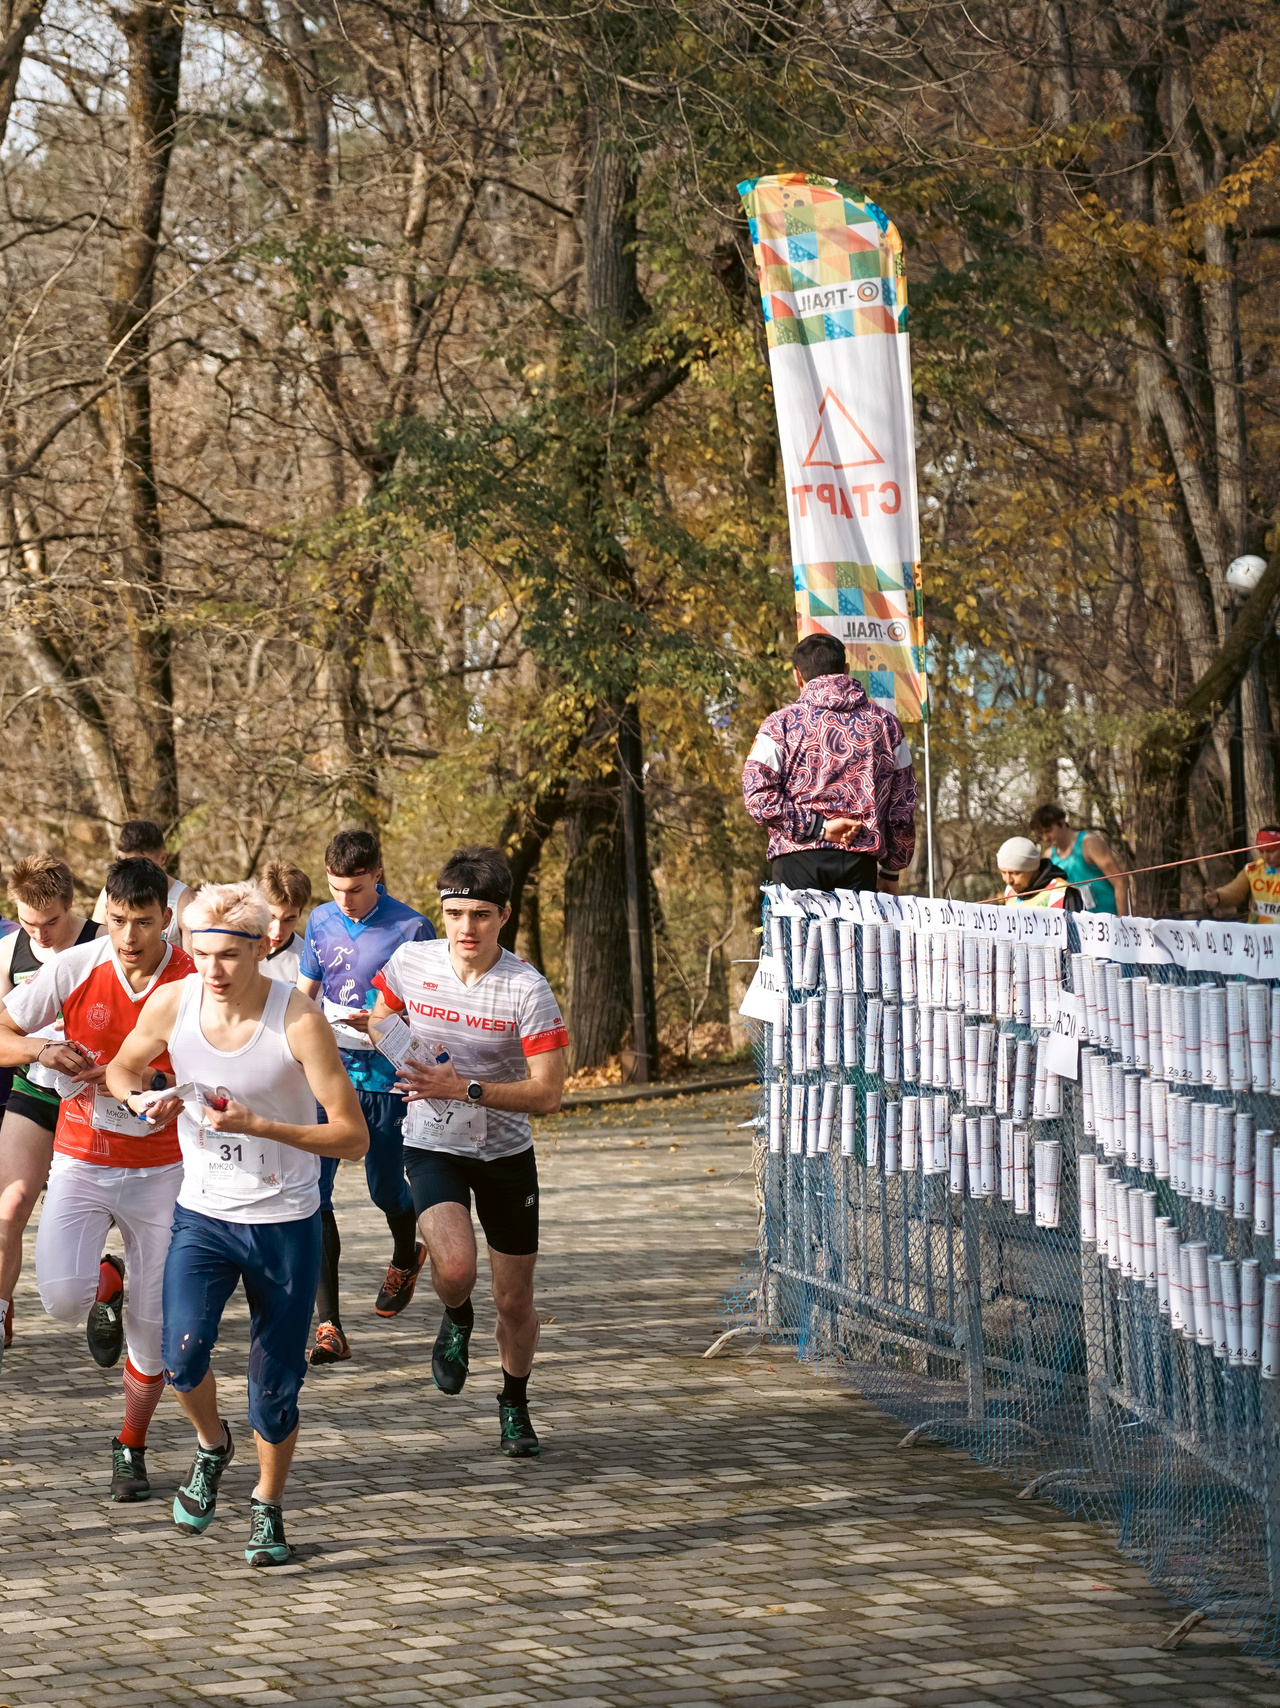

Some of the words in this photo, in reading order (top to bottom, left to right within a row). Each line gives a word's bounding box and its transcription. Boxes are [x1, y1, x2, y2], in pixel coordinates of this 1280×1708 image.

[924, 906, 931, 923] 9
[940, 908, 951, 924] 10
[988, 913, 998, 931] 13
[1006, 916, 1016, 934] 14
[1024, 916, 1034, 934] 15
[1098, 922, 1110, 942] 33
[1206, 932, 1217, 954] 41
[1223, 933, 1233, 956] 42
[1244, 934, 1255, 958] 43
[1264, 936, 1274, 959] 44
[409, 999, 460, 1023] NORD
[466, 1014, 517, 1032] WEST
[106, 1109, 128, 1120] МЖ20
[424, 1120, 444, 1130] МЖ20
[220, 1144, 242, 1162] 31
[260, 1154, 264, 1164] 1
[208, 1162, 234, 1171] МЖ20
